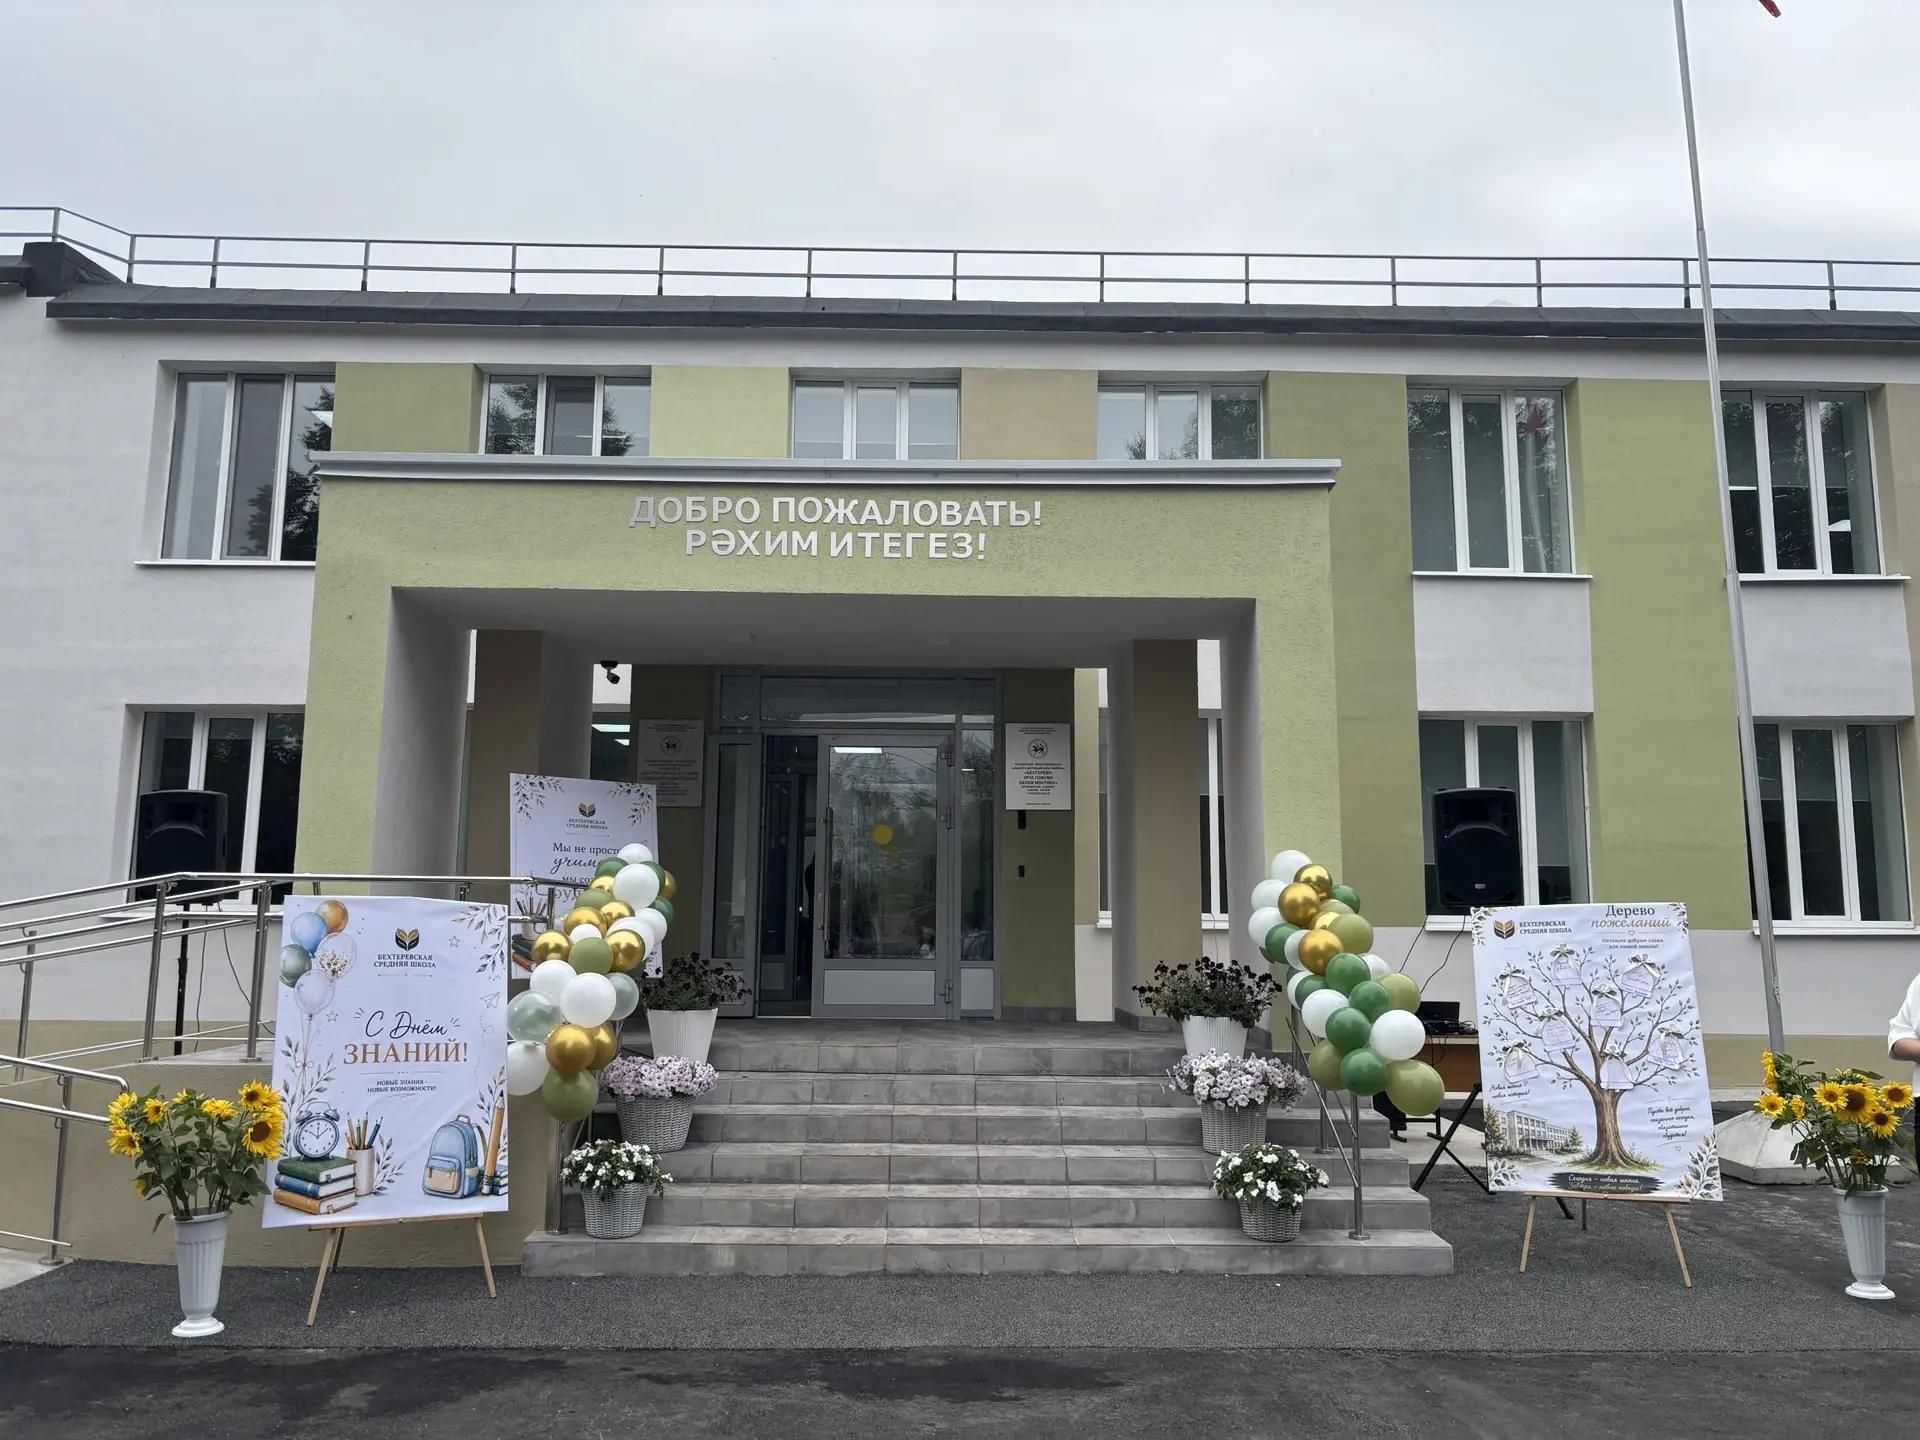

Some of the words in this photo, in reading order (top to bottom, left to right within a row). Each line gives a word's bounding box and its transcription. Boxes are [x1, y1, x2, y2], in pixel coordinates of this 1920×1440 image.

[629, 496, 761, 528] ДОБРО
[772, 497, 1042, 527] ПОЖАЛОВАТЬ!
[685, 529, 818, 556] РӘХИМ
[829, 532, 987, 559] ИТЕГЕЗ!
[552, 842, 571, 852] Мы
[574, 845, 586, 853] не
[550, 857, 599, 874] учим
[1605, 905, 1655, 919] Дерево
[1519, 920, 1566, 928] БЕХТЕРЕВСКАЯ
[1591, 917, 1672, 928] пожеланий
[1548, 927, 1572, 935] ШКОЛА
[377, 953, 433, 961] БЕХТЕРЕВСКАЯ
[410, 961, 436, 969] ШКОЛА
[389, 1011, 448, 1040] Днём
[343, 1038, 468, 1065] ЗНАНИЙ!
